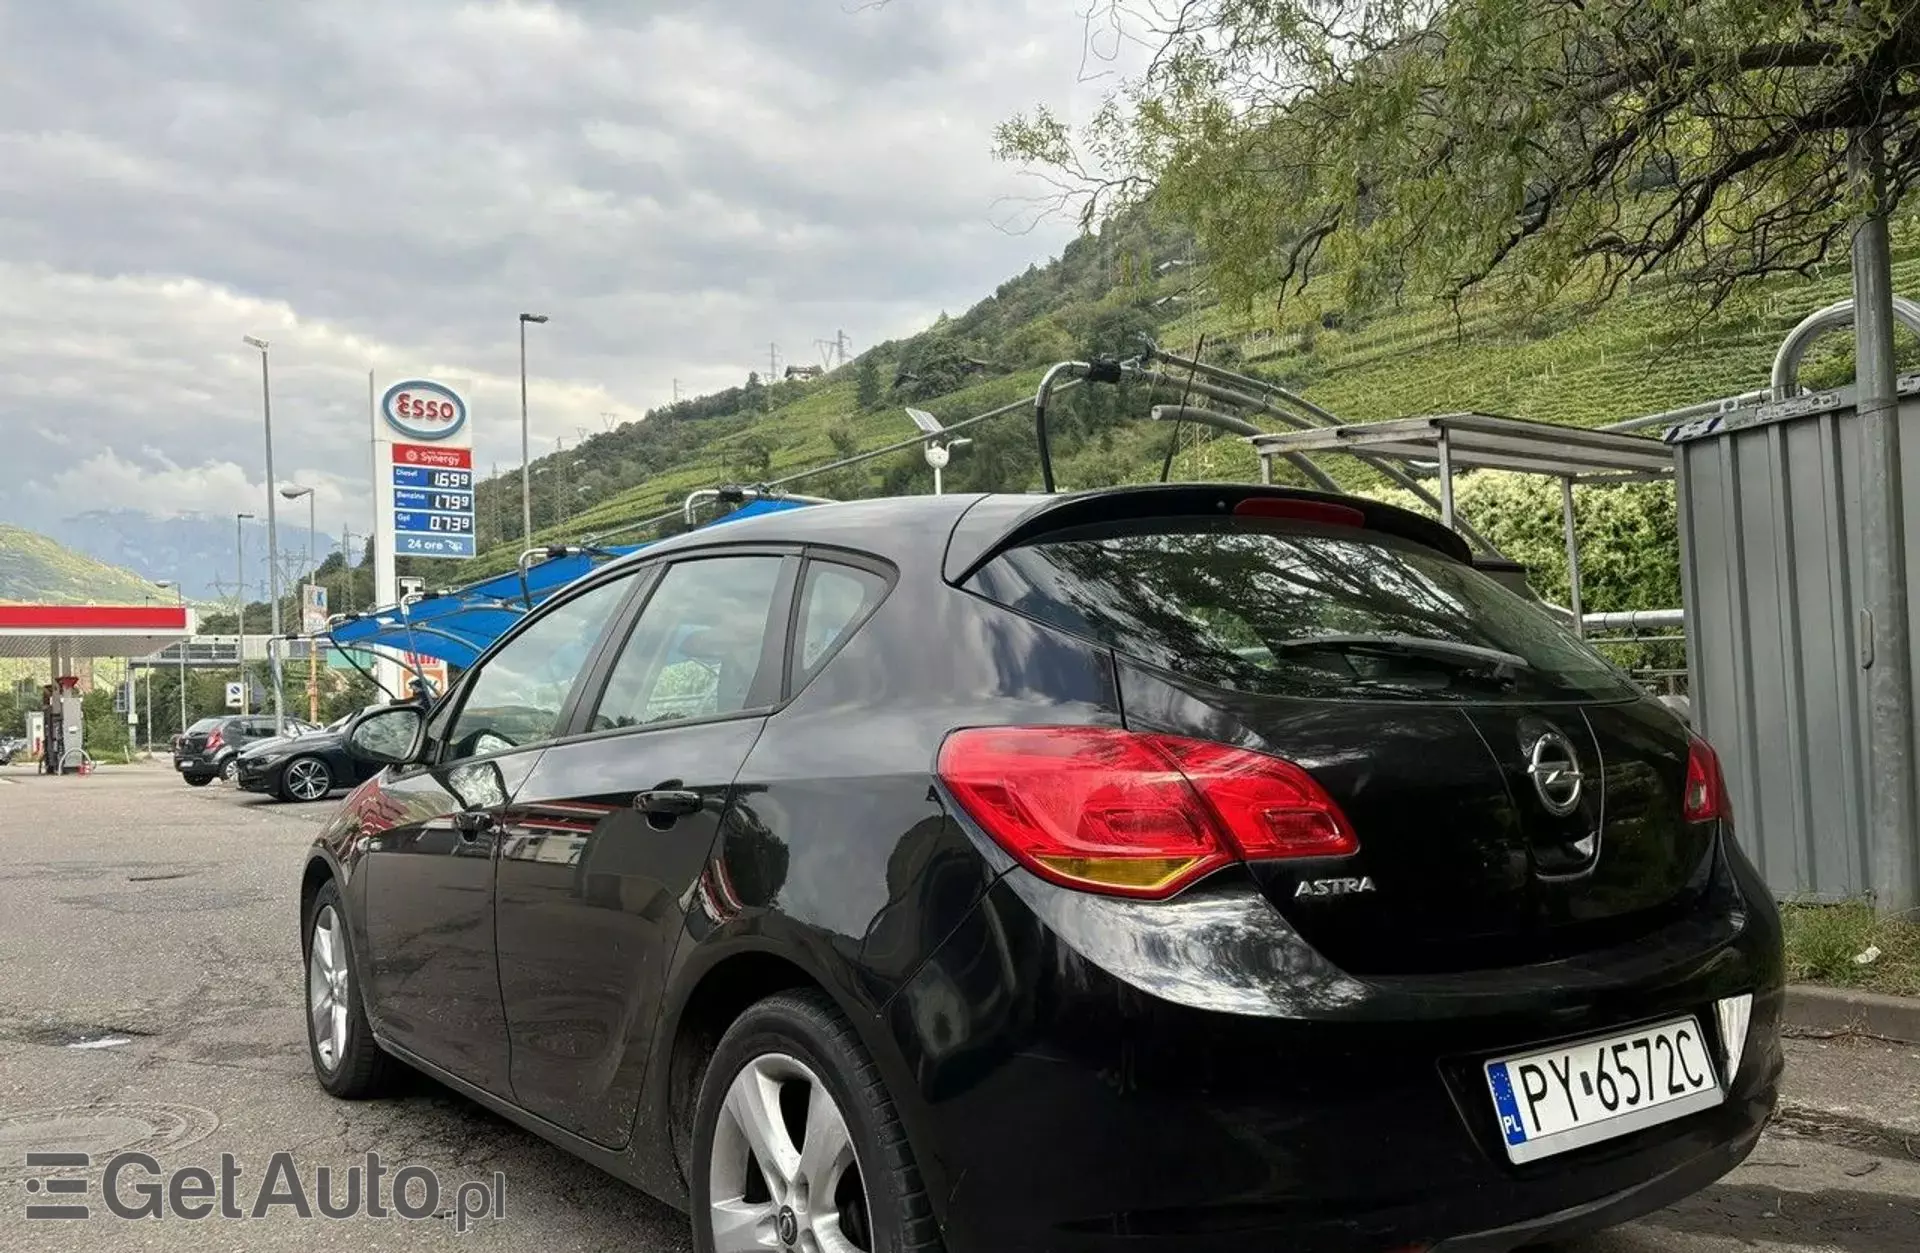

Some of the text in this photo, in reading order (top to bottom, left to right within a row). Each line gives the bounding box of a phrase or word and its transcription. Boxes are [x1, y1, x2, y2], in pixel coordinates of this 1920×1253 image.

[420, 451, 460, 466] Synergy
[395, 468, 418, 477] Diesel
[396, 491, 425, 500] Benzina
[407, 538, 443, 550] 24 ore
[1294, 876, 1377, 898] ASTRA
[1518, 1029, 1704, 1132] PY 6572C
[1503, 1115, 1522, 1135] PL
